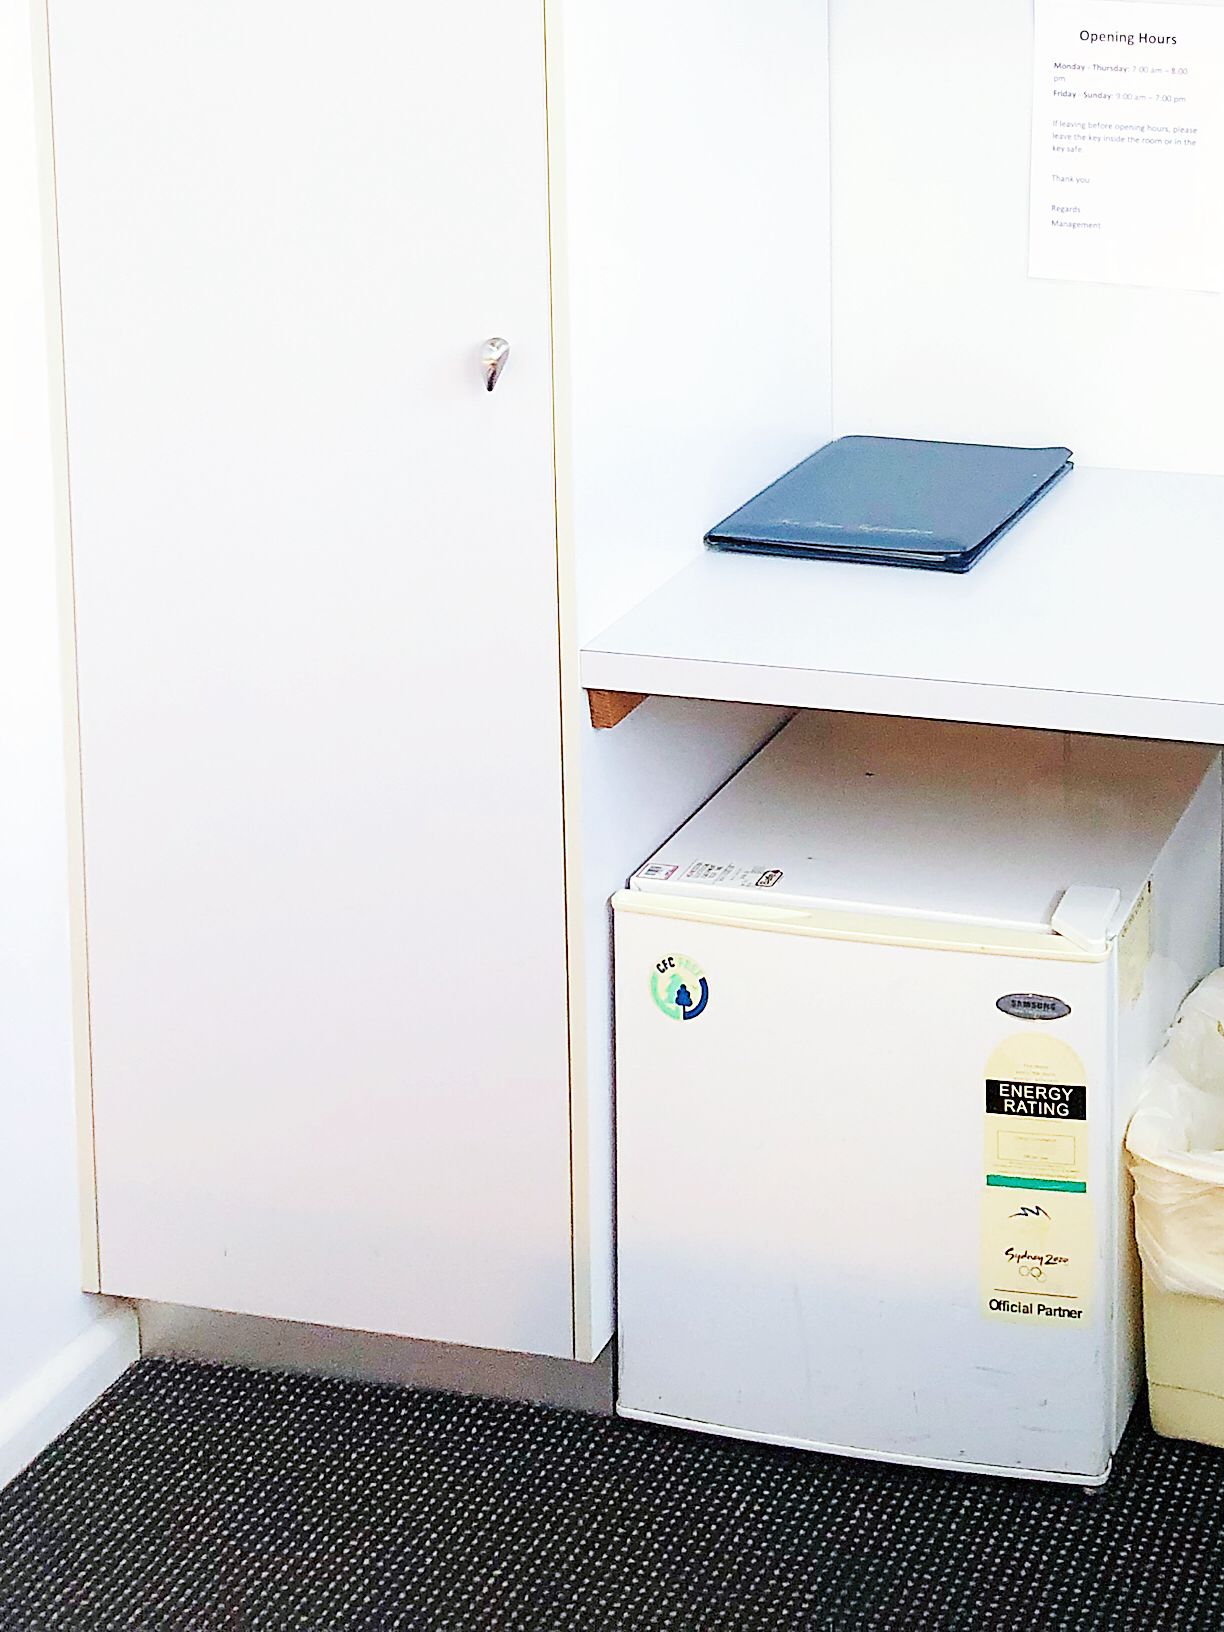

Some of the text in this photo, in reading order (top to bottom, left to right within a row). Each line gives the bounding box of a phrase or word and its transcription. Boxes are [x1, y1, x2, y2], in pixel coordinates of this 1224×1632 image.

[1079, 30, 1177, 46] Opening Hours
[1054, 62, 1085, 72] Monday
[1053, 75, 1066, 83] pm
[1053, 89, 1076, 99] Friday
[1060, 120, 1086, 129] leaving
[1088, 121, 1113, 129] before
[1115, 123, 1145, 133] opening
[1173, 126, 1198, 134] please
[1053, 132, 1072, 140] leave
[1088, 134, 1101, 142] key
[1103, 135, 1125, 143] inside
[1184, 138, 1196, 146] the
[1053, 145, 1065, 153] key
[1051, 175, 1074, 183] Thank
[1051, 205, 1080, 213] Regards
[1051, 220, 1101, 229] Management
[656, 956, 675, 973] CFC
[1011, 1000, 1056, 1011] SAMSUNG
[1000, 1084, 1073, 1101] ENERGY
[1004, 1099, 1069, 1116] RATING
[1004, 1247, 1043, 1266] Sydney
[989, 1299, 1083, 1318] Official Partner
